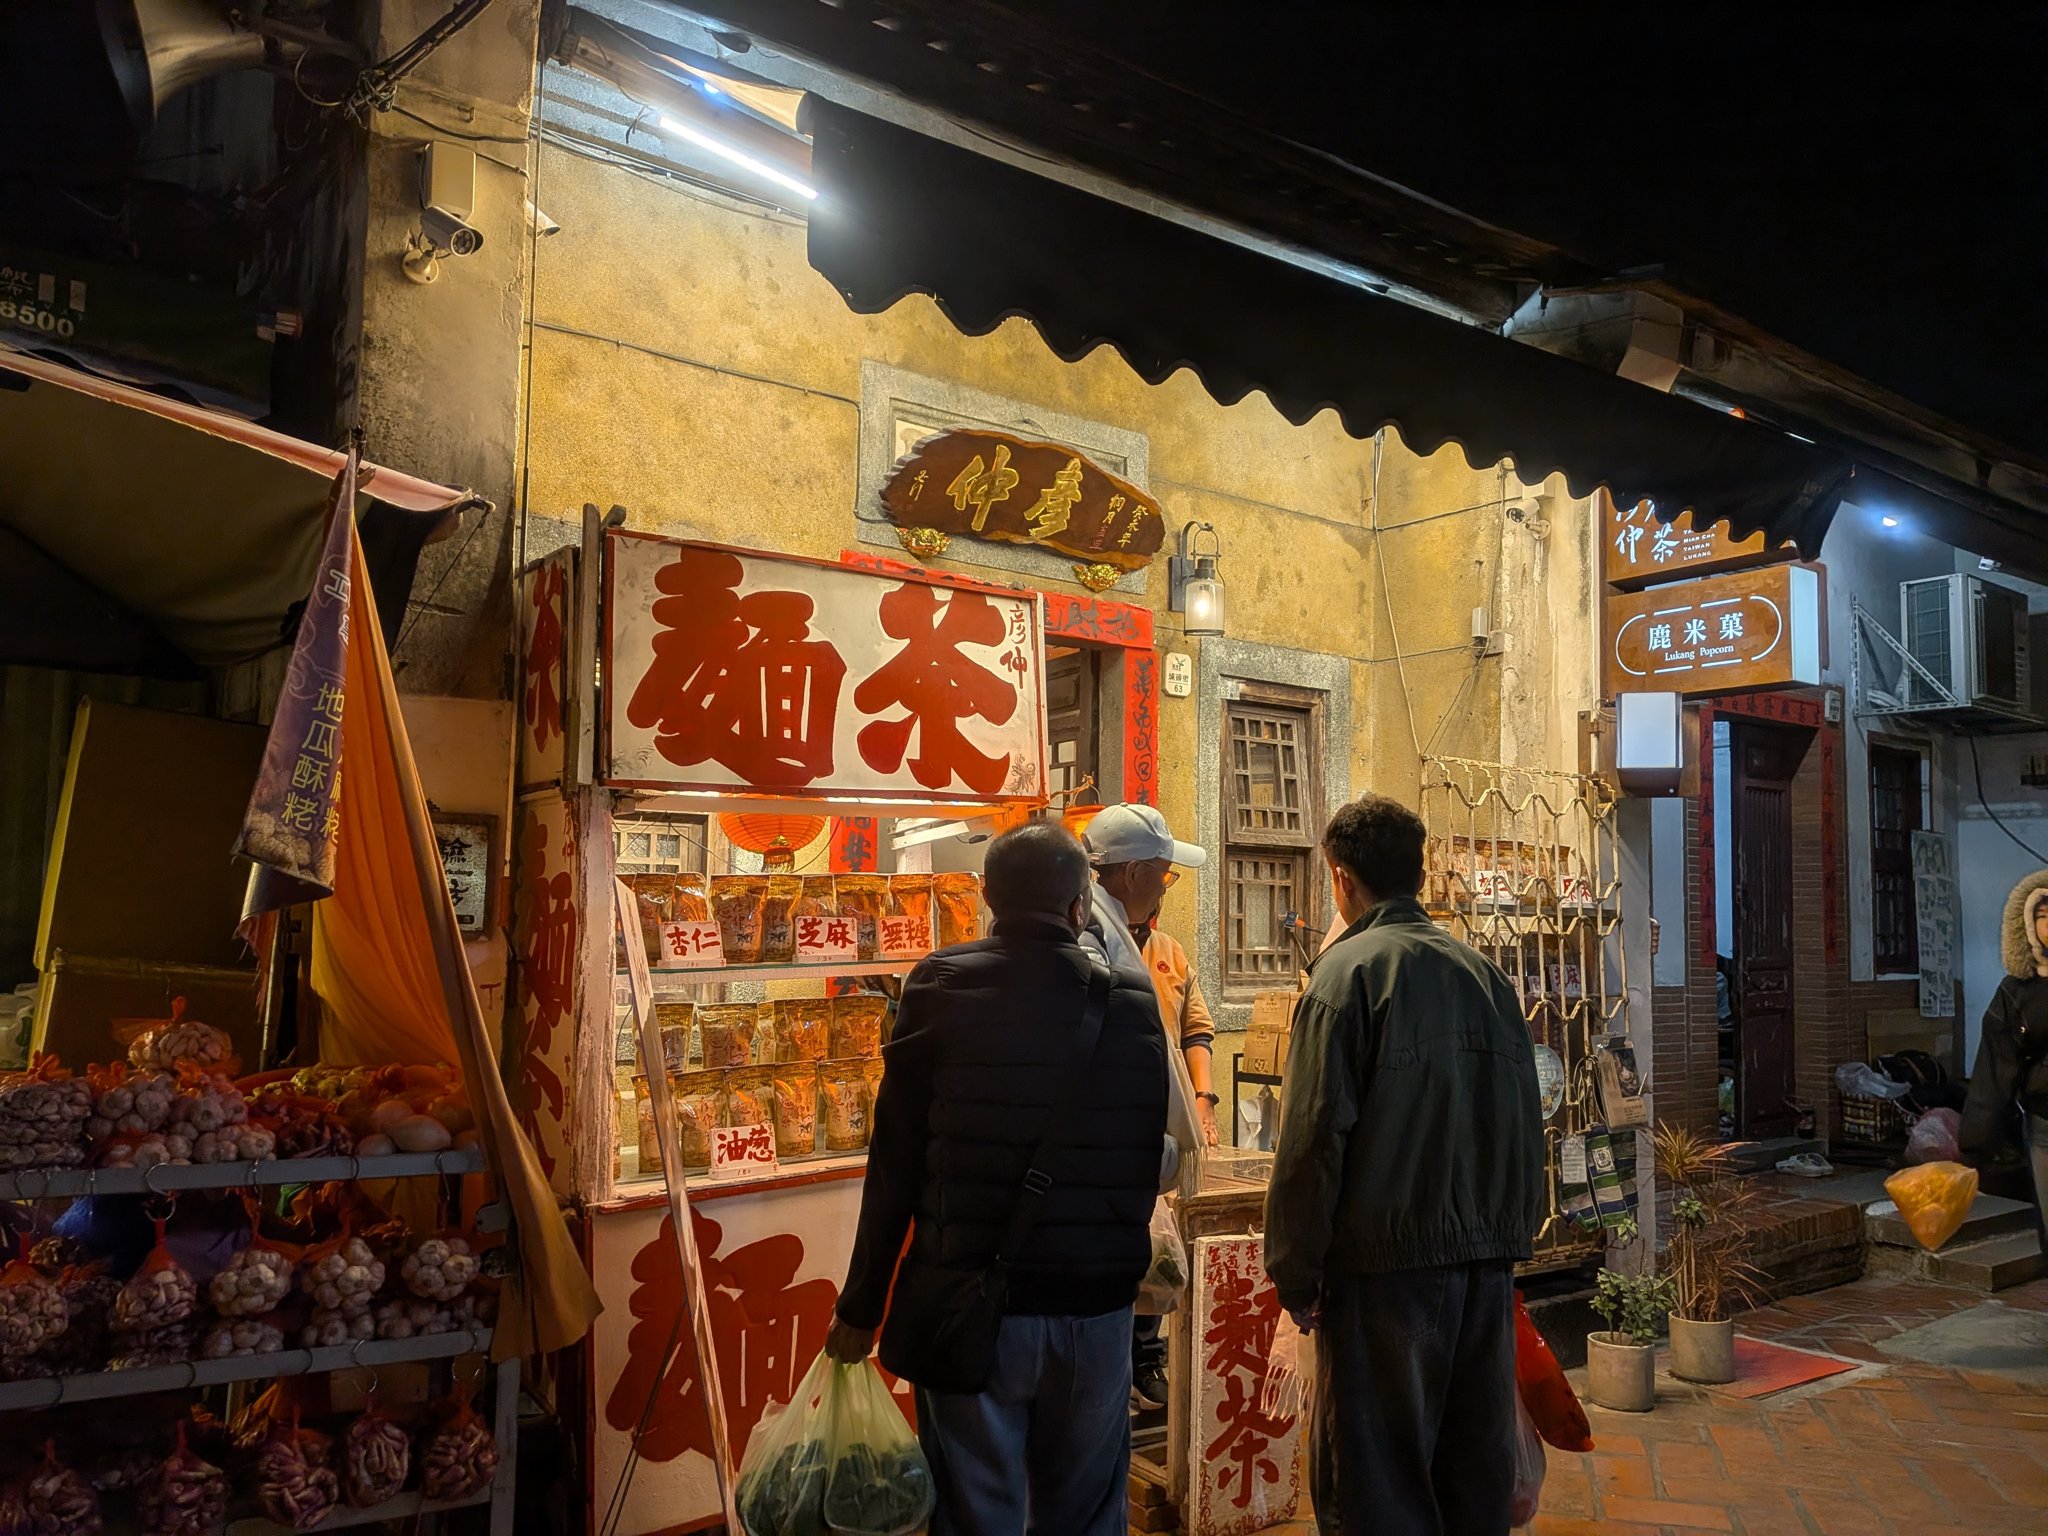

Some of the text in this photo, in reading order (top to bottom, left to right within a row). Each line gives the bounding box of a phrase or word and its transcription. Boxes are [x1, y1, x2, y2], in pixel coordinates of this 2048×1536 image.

[1683, 542, 1711, 551] TAIWAN
[1683, 550, 1712, 560] LUKANG
[1000, 604, 1027, 689] 彥仲
[1648, 612, 1743, 651] 鹿米菓
[1664, 644, 1734, 661] Lukang Popcorn
[628, 547, 1018, 794] 麵茶
[1174, 685, 1184, 694] 63
[667, 926, 721, 956] 杏仁
[798, 917, 857, 949] 芝麻
[882, 916, 931, 951] 無糖
[606, 1207, 918, 1477] 麵
